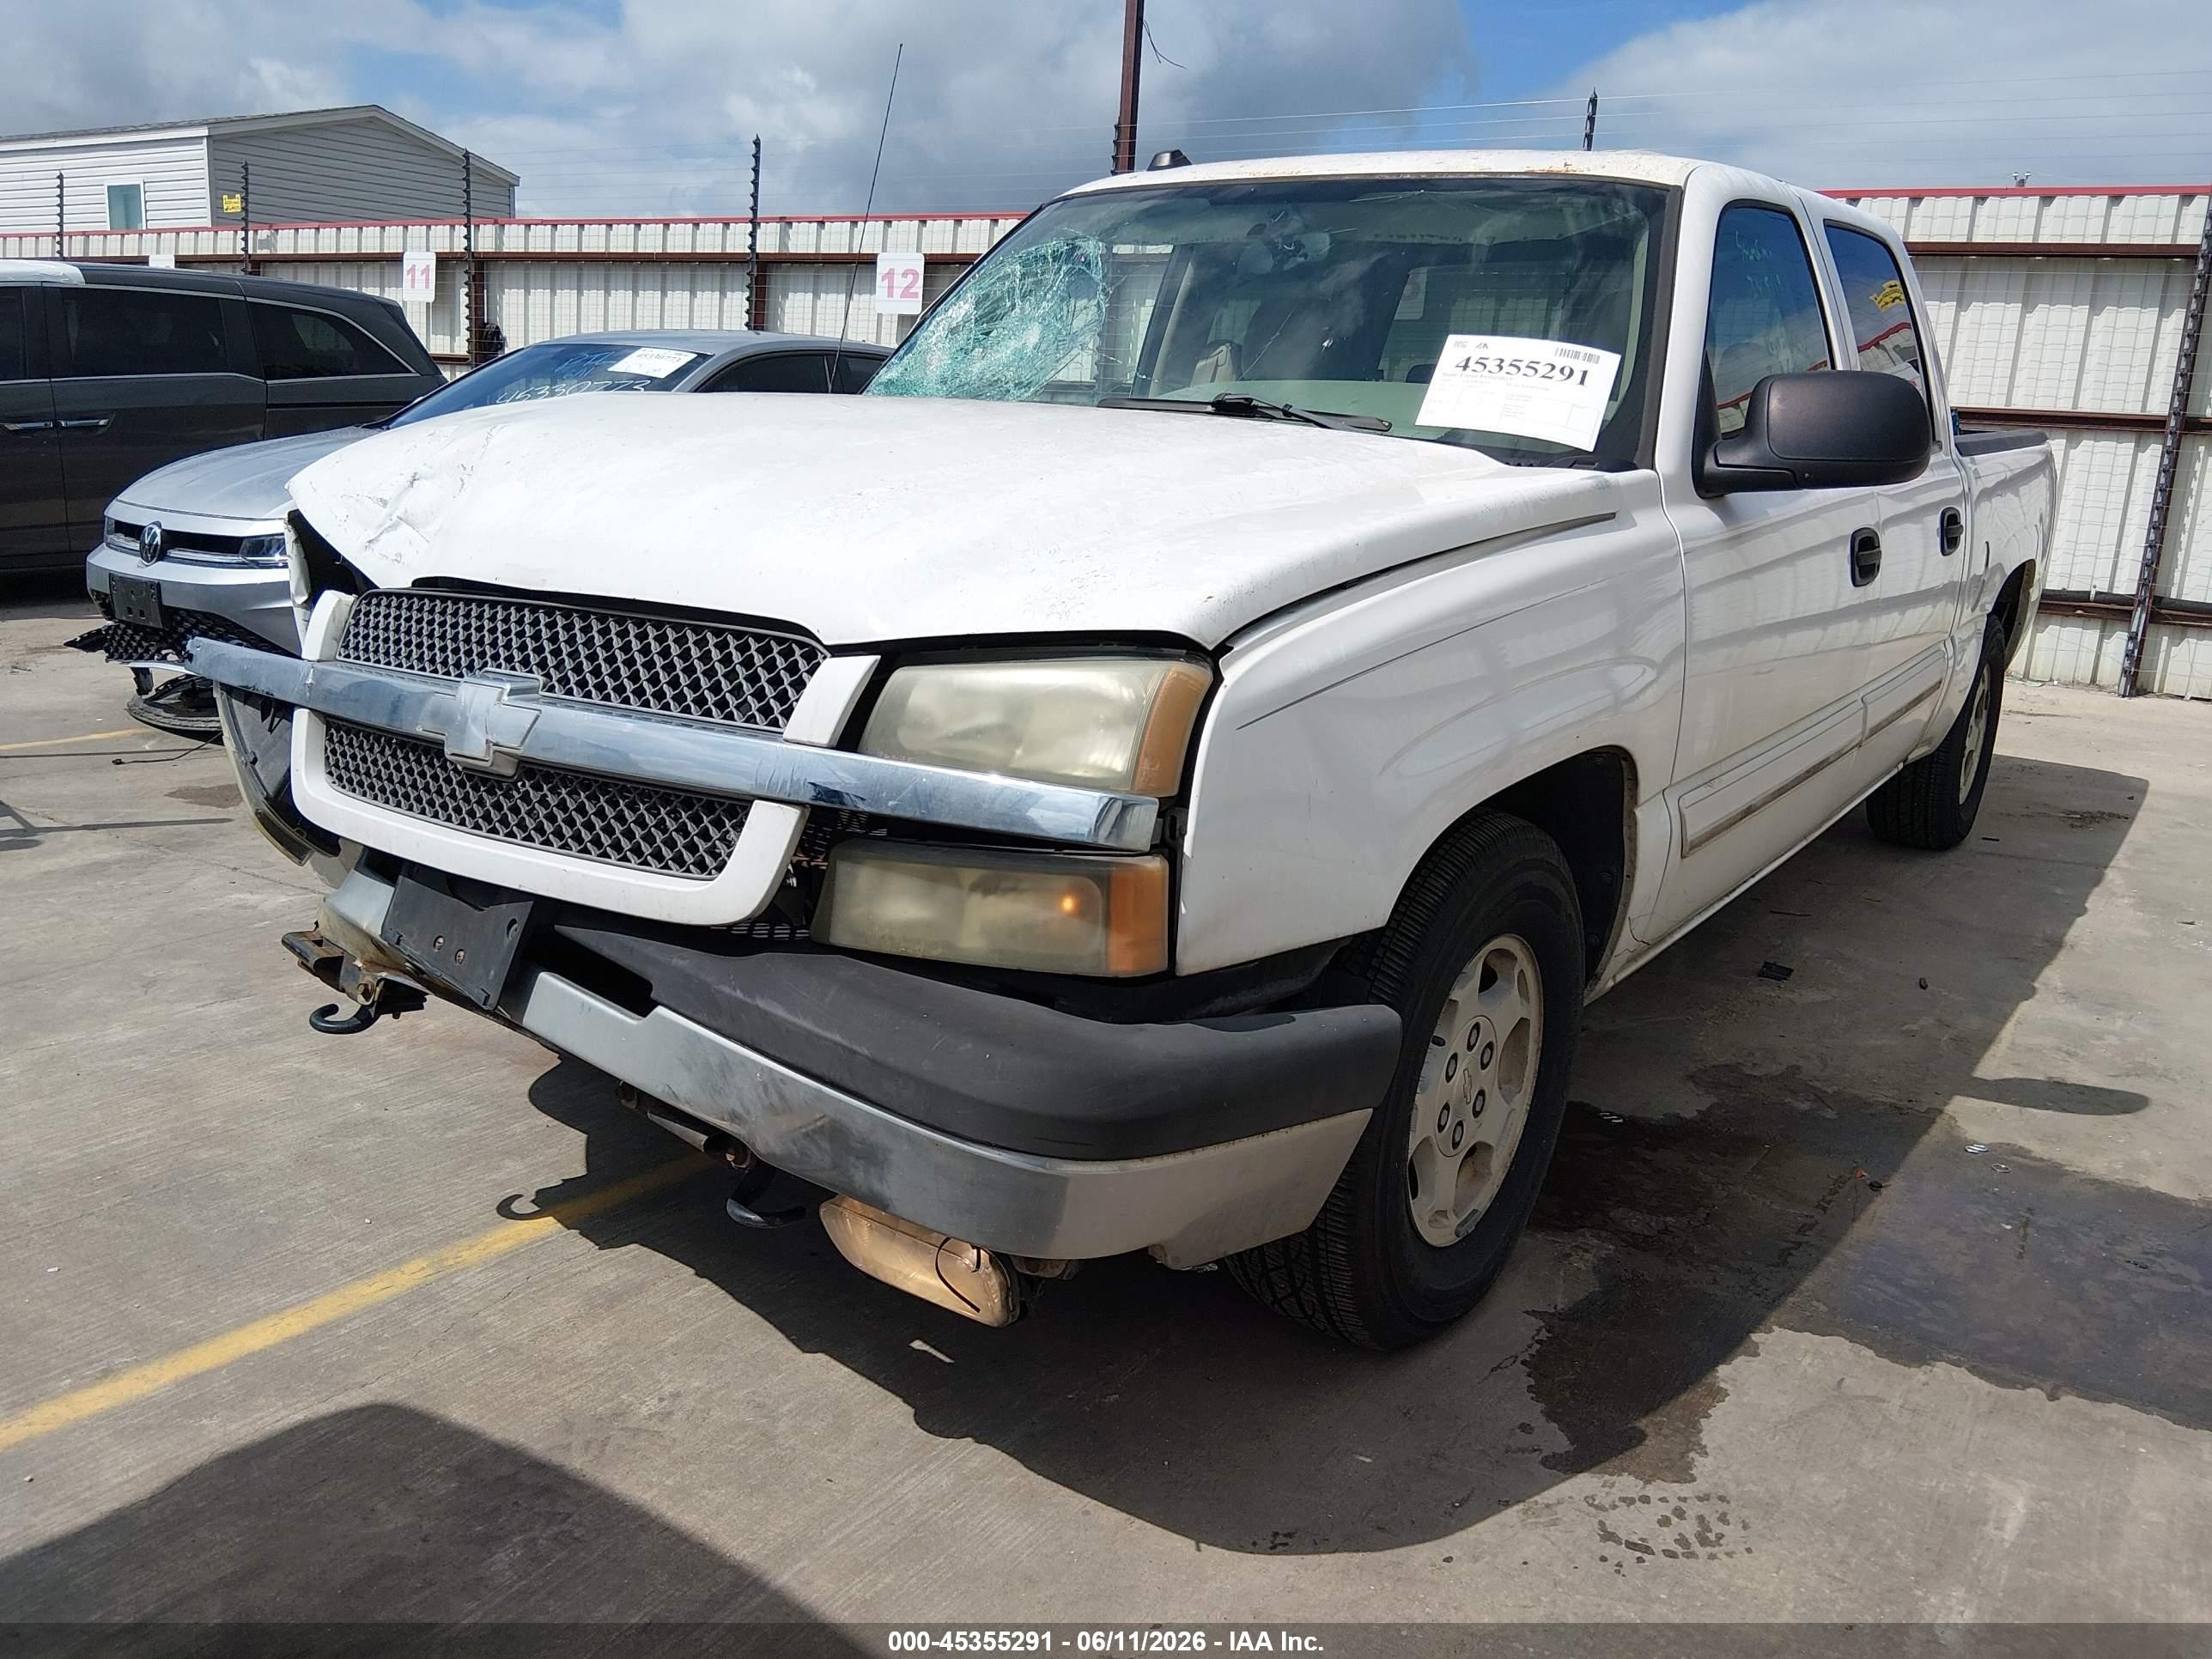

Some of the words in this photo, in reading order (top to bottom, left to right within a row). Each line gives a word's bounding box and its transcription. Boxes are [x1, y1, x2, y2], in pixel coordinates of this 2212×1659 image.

[406, 264, 430, 289] 11
[881, 268, 920, 298] 12
[1455, 356, 1589, 387] 45355291
